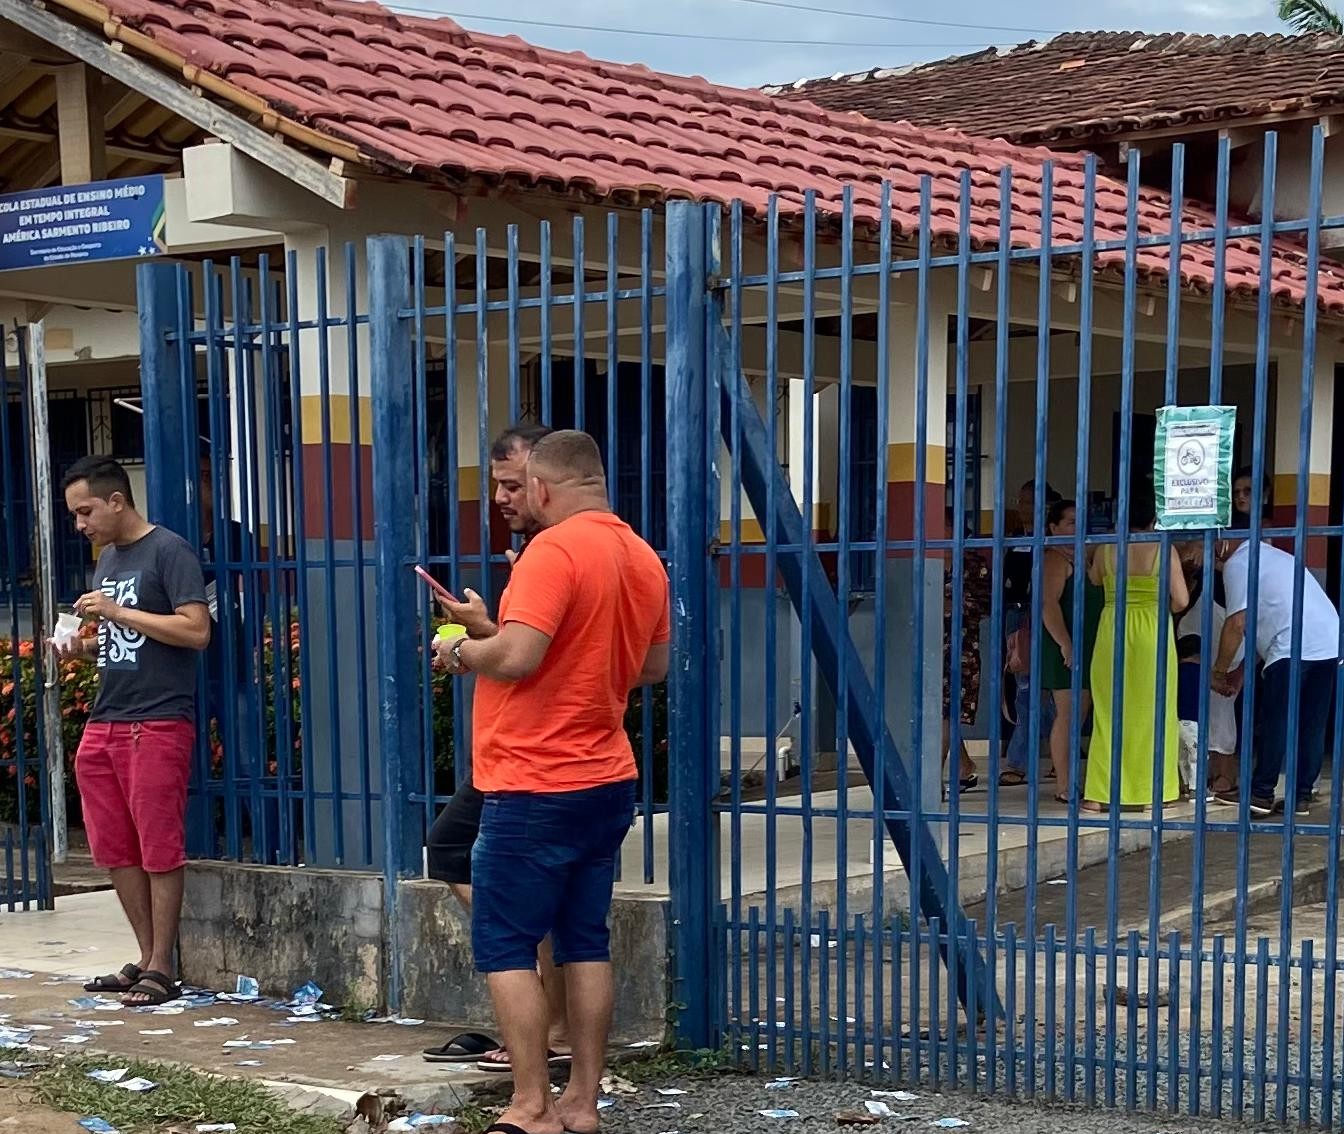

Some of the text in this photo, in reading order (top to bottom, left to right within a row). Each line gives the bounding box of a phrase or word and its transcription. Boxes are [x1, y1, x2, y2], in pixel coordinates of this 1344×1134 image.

[20, 195, 62, 211] ESTADUAL
[63, 193, 76, 204] DE
[77, 189, 113, 203] ENSINO
[114, 184, 145, 199] MÉDIO
[19, 205, 110, 227] EM TEMPO INTEGRAL
[3, 219, 130, 244] AMÉRICA SARMENTO RIBEIRO
